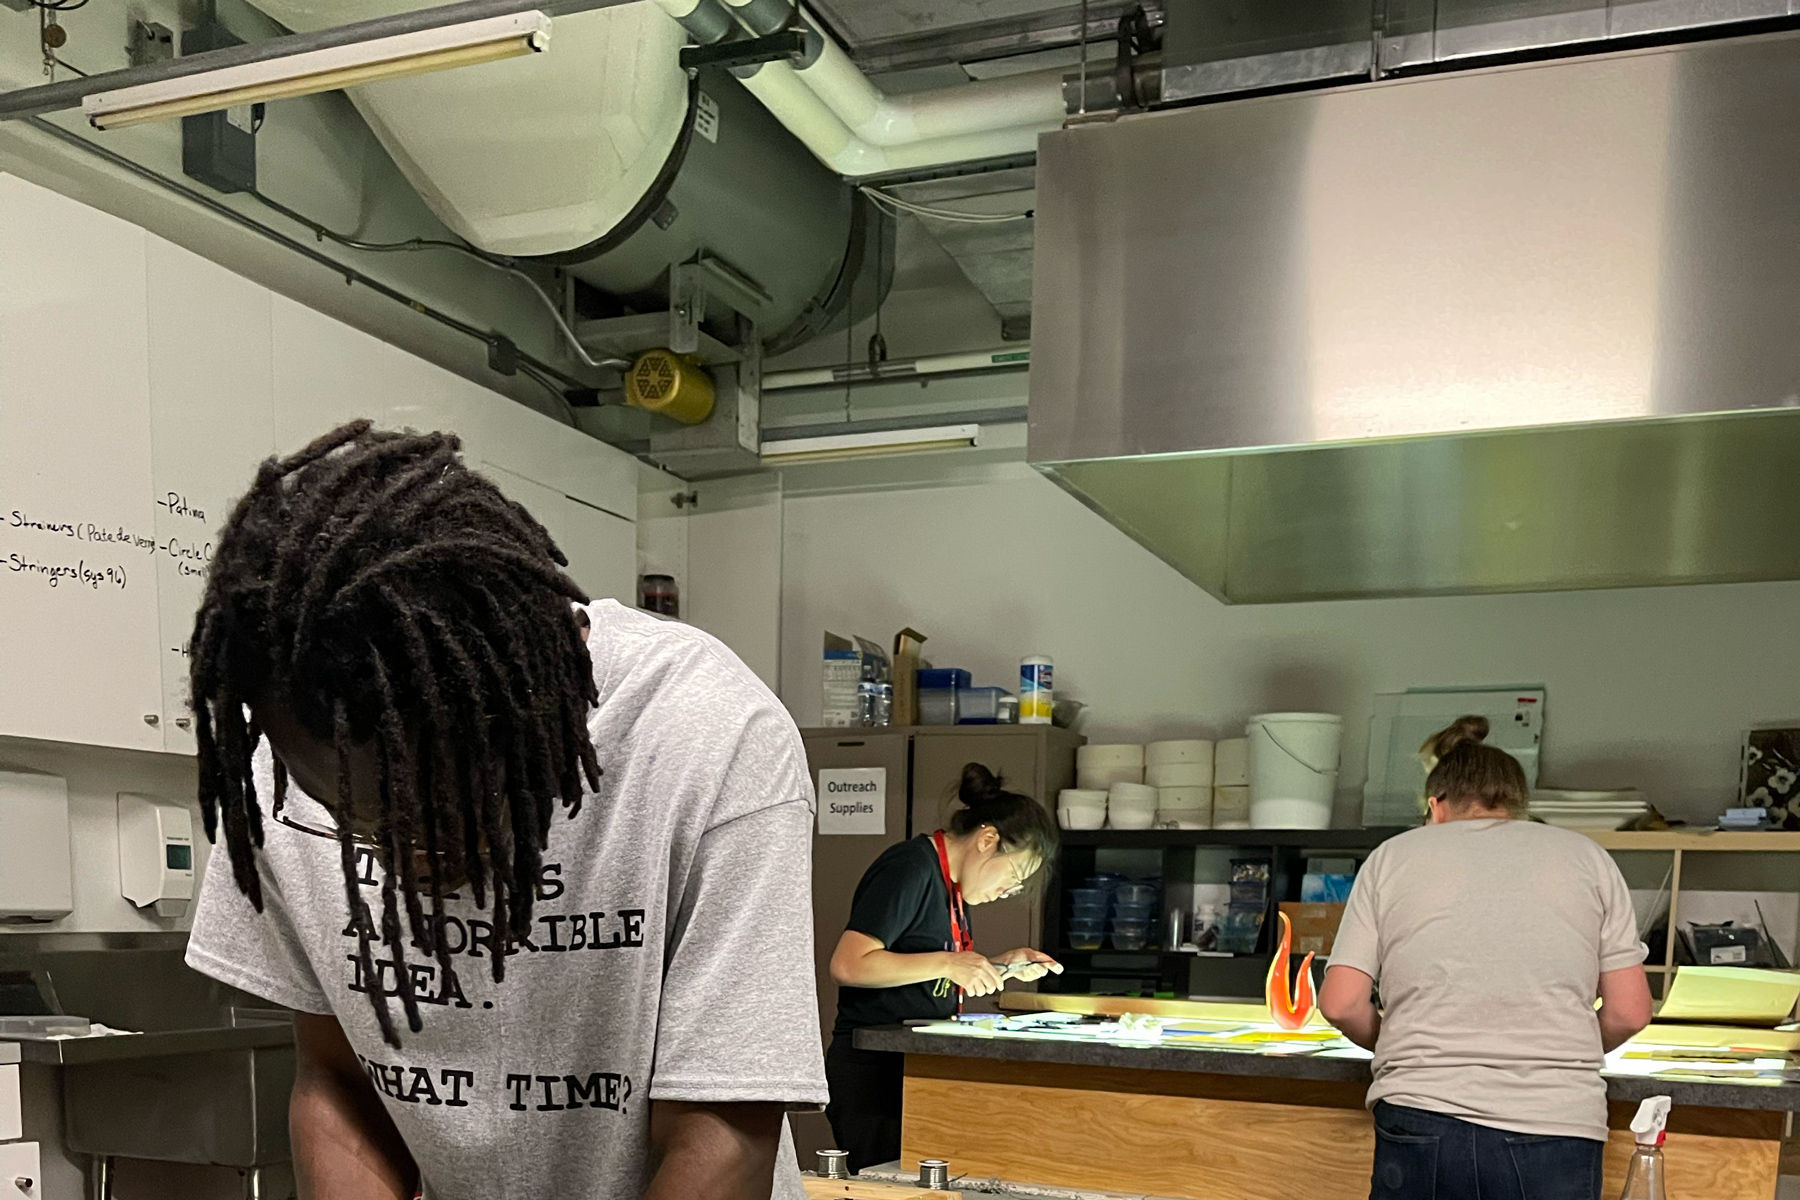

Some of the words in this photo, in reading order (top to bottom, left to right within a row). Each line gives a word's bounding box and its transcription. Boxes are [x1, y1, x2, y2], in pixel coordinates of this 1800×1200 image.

[827, 780, 877, 793] Outreach
[829, 802, 874, 817] Supplies
[507, 1072, 632, 1114] TIME?
